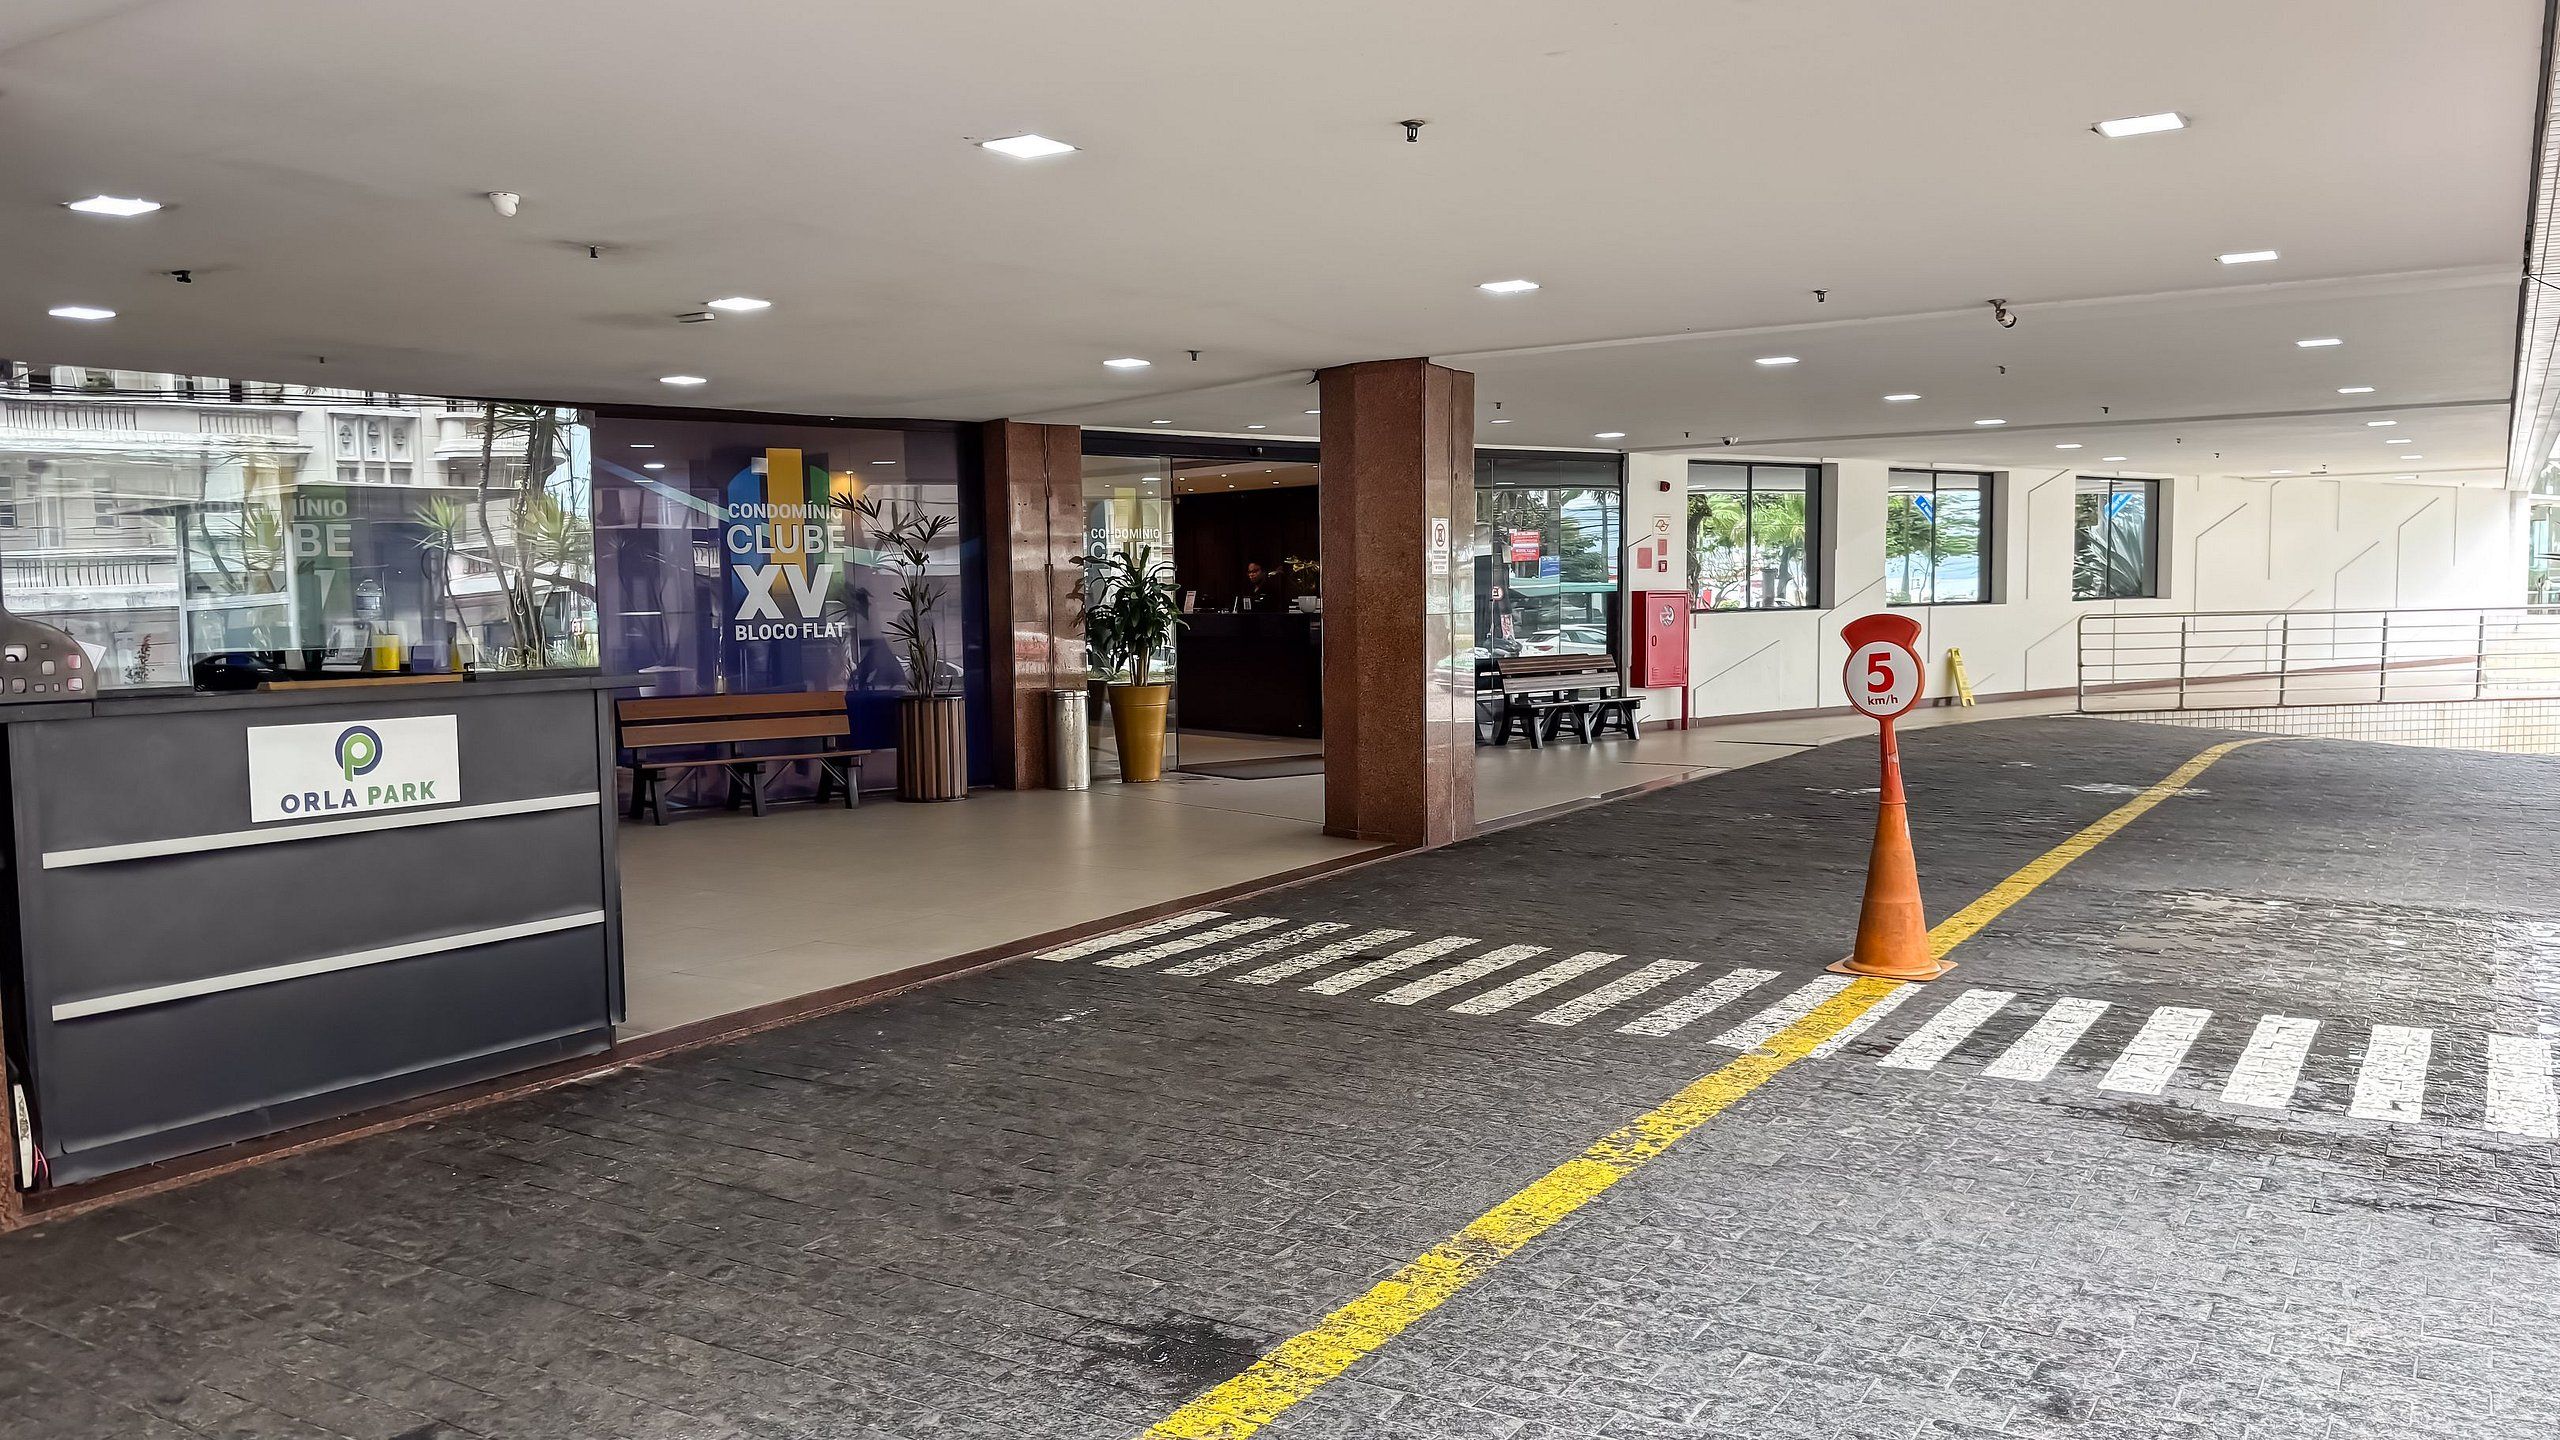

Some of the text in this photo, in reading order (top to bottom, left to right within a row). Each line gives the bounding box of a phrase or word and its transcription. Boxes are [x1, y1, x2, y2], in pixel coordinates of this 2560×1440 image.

[728, 500, 842, 519] CONDOMÍNIO
[726, 524, 846, 554] CLUBE
[732, 564, 835, 620] XV
[735, 622, 846, 641] BLOCO FLAT
[1867, 652, 1895, 693] 5
[1867, 694, 1898, 706] km/h
[281, 780, 436, 814] ORLA PARK
